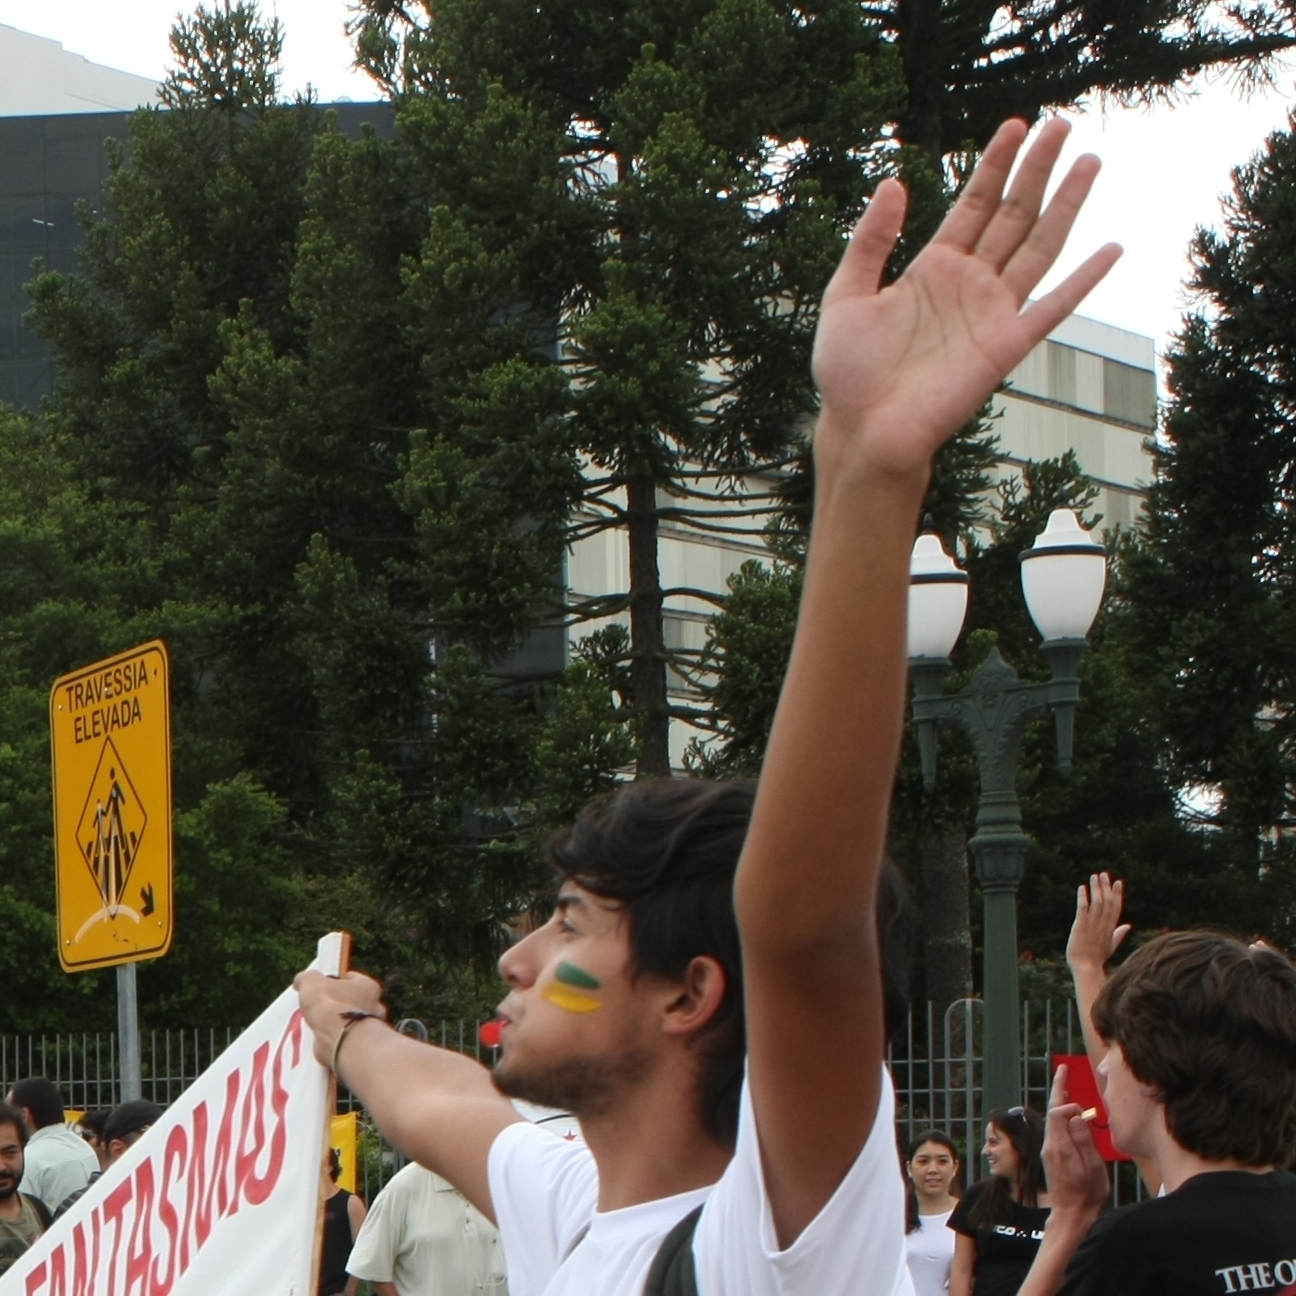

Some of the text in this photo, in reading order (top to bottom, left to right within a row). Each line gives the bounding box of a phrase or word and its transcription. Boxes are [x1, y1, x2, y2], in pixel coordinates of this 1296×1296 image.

[65, 659, 149, 713] TRAVESSIA
[74, 696, 142, 744] ELEVADA
[1214, 1262, 1275, 1294] THE
